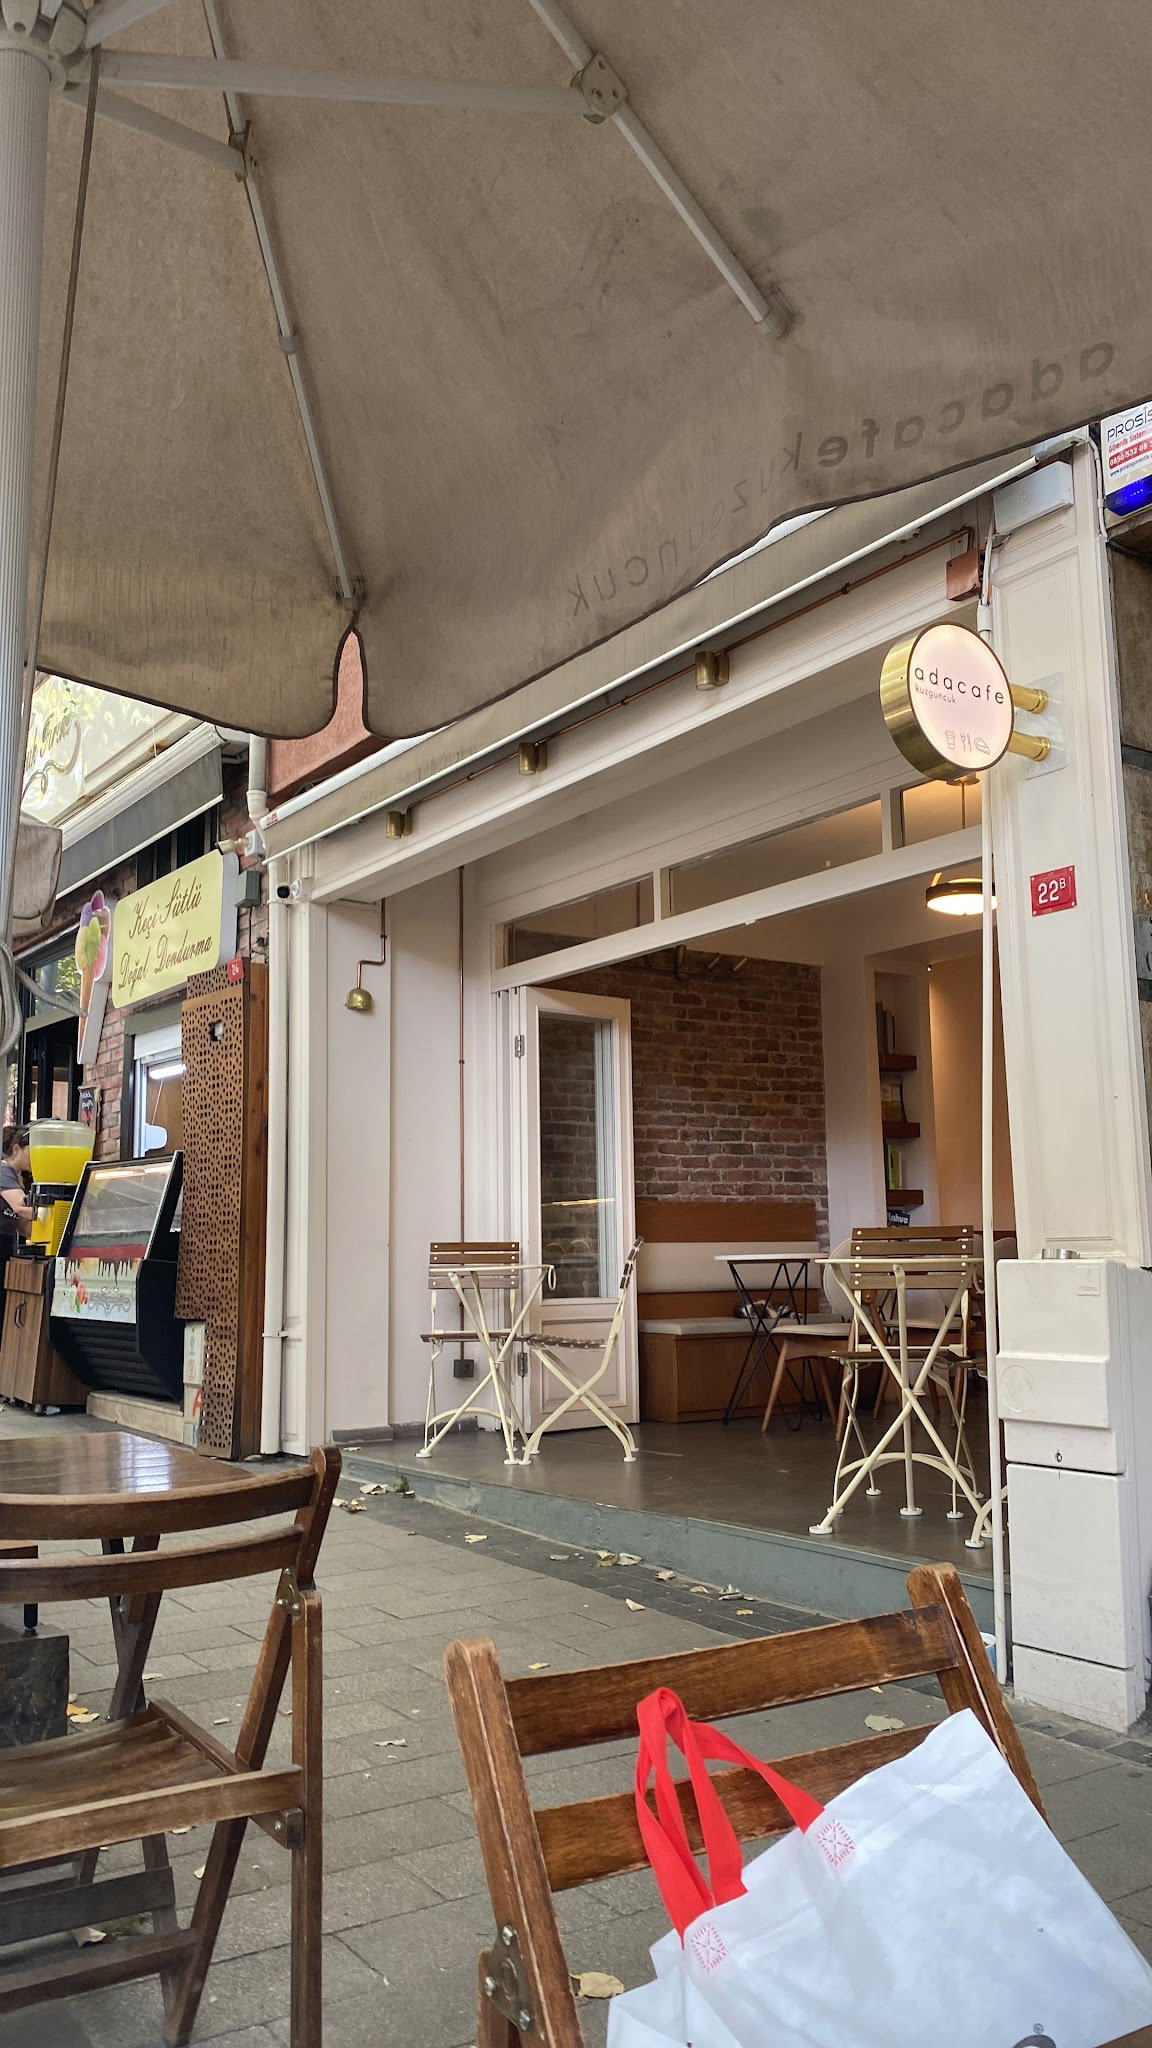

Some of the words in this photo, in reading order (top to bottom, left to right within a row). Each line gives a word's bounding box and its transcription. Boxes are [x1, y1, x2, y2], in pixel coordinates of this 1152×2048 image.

[914, 667, 1005, 705] adacafe
[915, 683, 957, 705] kuzguncuk
[128, 896, 160, 939] Keçi
[159, 875, 203, 925] Sütlü
[1037, 877, 1067, 905] 22B
[118, 946, 152, 998] Doğal
[153, 929, 213, 975] Dondurma
[231, 962, 240, 976] 24
